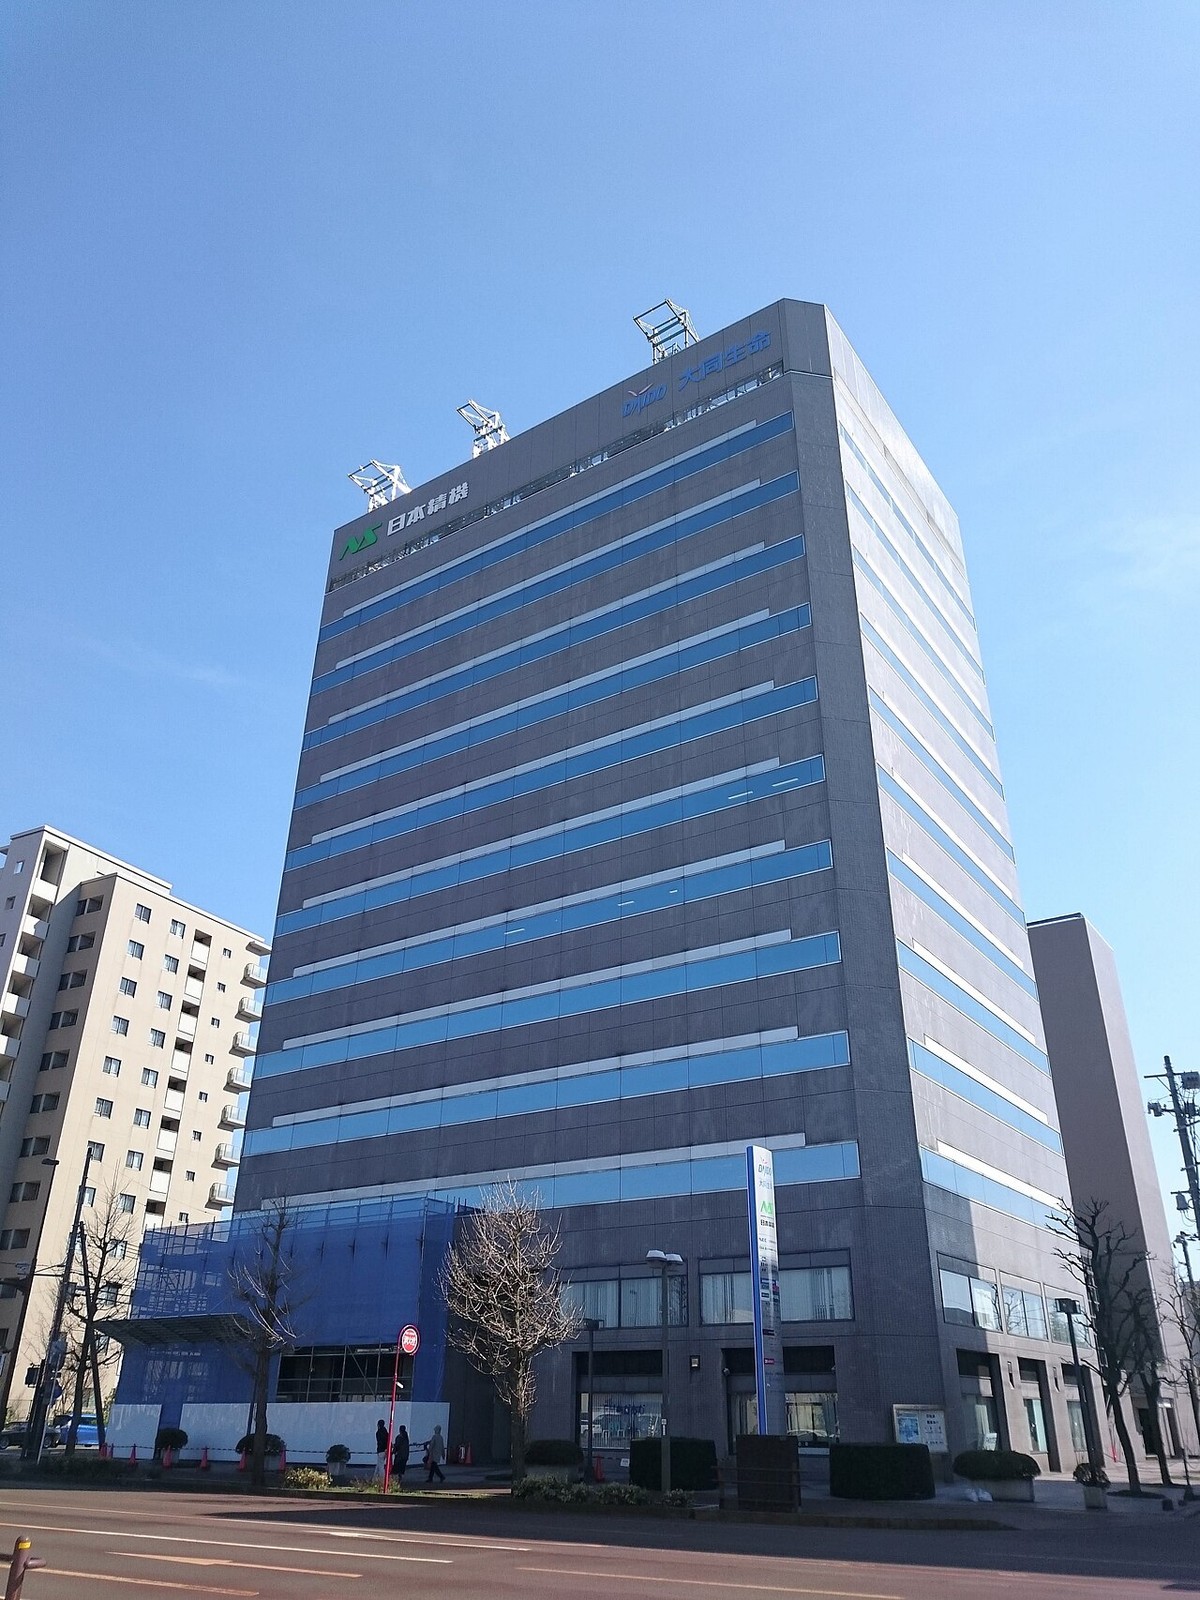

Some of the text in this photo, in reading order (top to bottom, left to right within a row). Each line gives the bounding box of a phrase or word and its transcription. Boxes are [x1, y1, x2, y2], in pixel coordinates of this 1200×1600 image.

[677, 330, 772, 392] 大同生命
[387, 481, 469, 537] 日本精機
